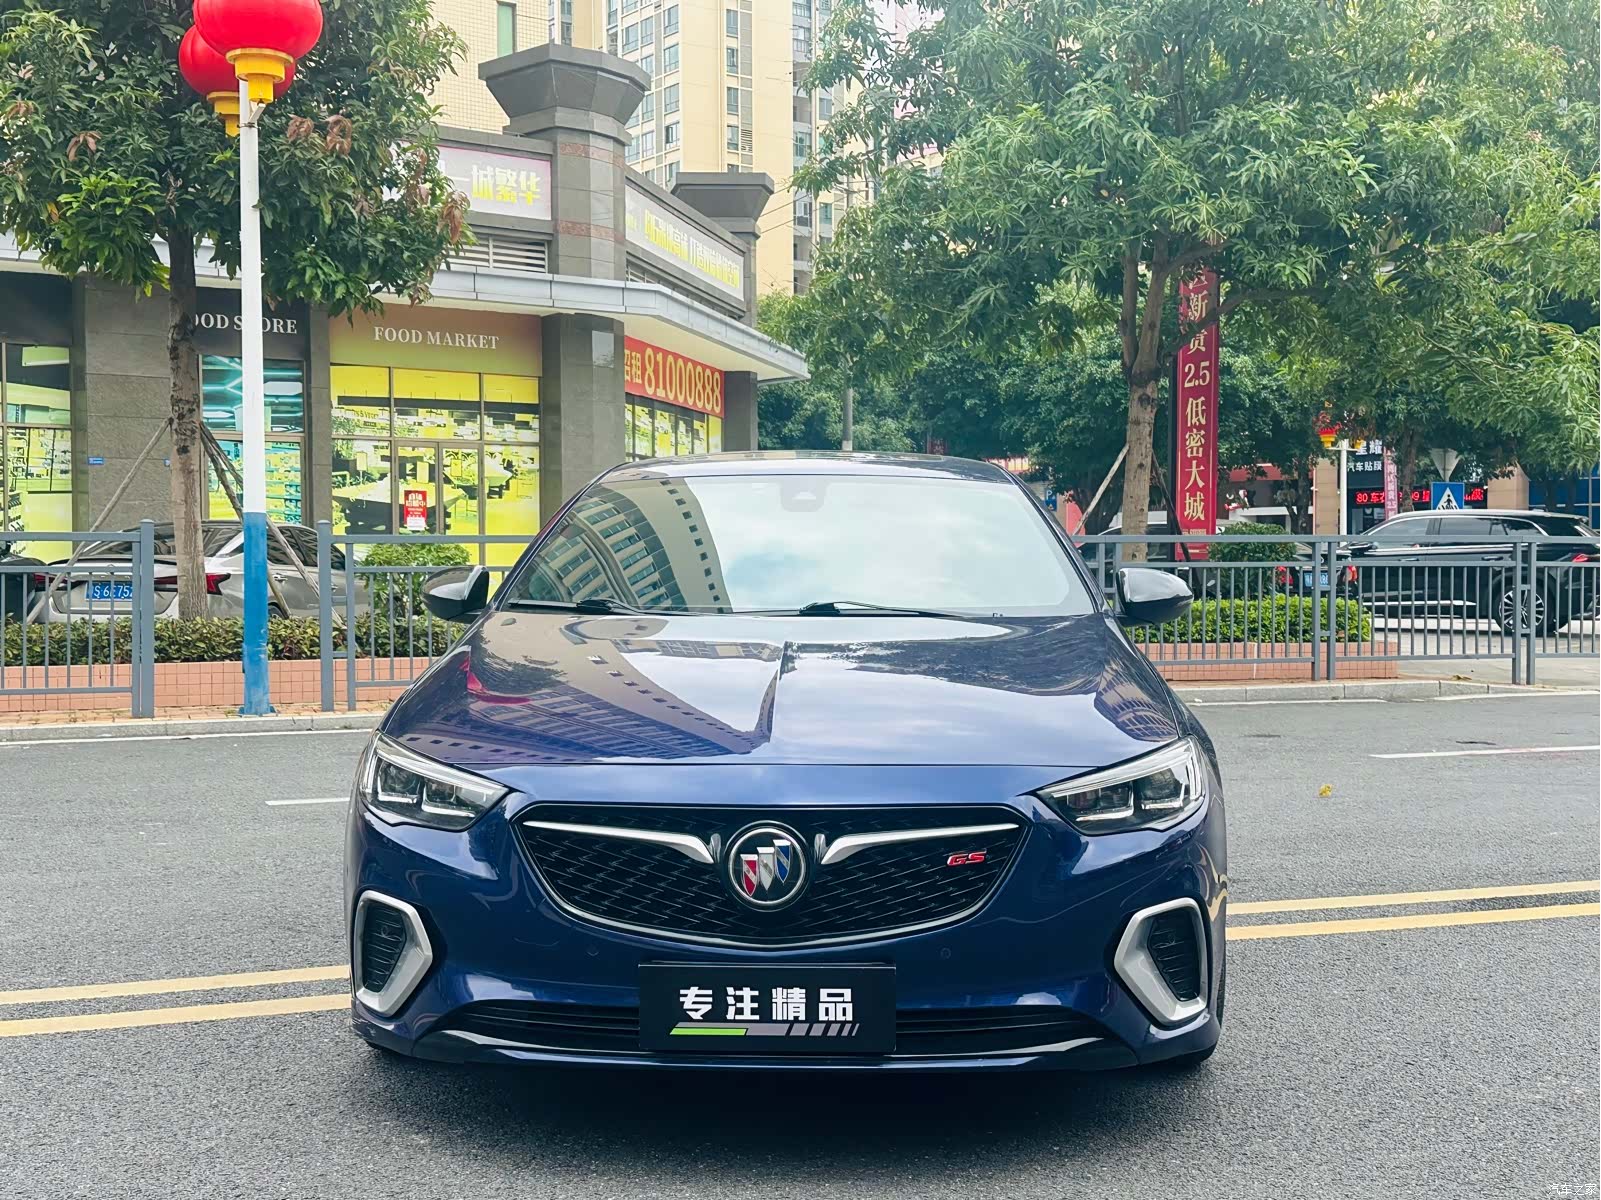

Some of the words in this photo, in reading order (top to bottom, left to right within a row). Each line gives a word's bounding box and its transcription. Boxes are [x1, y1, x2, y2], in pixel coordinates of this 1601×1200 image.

[440, 161, 541, 206] 一城繁华
[233, 315, 298, 334] SORE
[374, 326, 423, 344] FOOD
[426, 331, 500, 350] MARKET
[644, 347, 721, 413] 81000888
[947, 851, 987, 866] GS
[679, 986, 853, 1022] 专注精品
